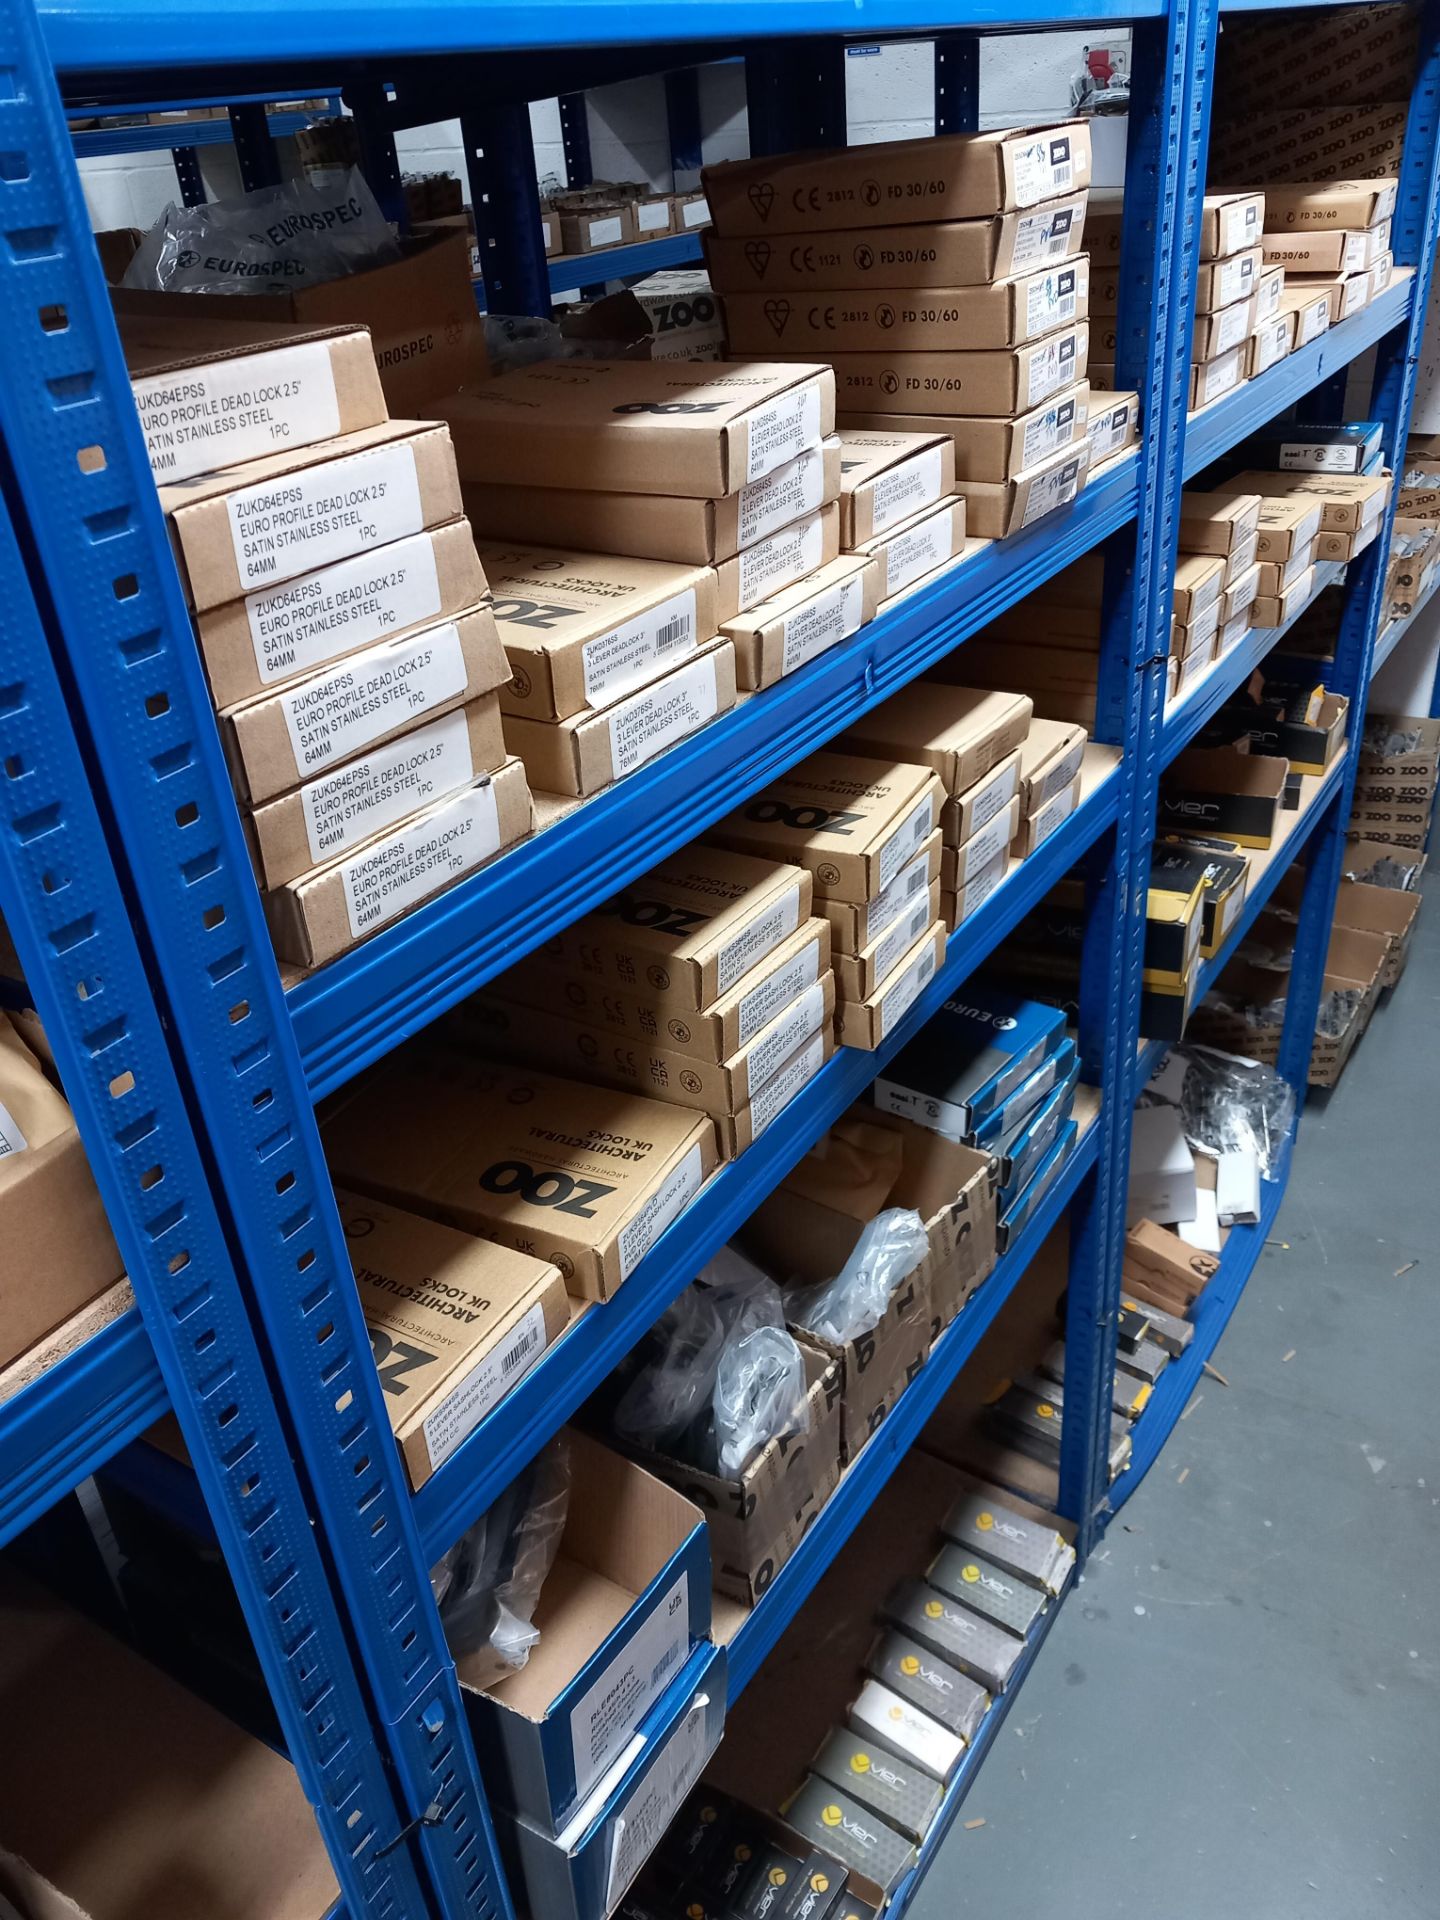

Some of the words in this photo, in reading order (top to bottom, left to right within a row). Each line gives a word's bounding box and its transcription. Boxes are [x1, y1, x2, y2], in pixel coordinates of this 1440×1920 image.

[1366, 31, 1393, 50] ZOO
[1335, 49, 1361, 70] ZOO
[1356, 63, 1383, 83] ZOO
[1328, 112, 1353, 131] ZOO
[1378, 112, 1404, 130] ZOO
[1350, 127, 1374, 144] ZOO
[1370, 140, 1394, 157] ZOO
[1340, 153, 1365, 170] ZOO
[1361, 166, 1386, 179] ZOO
[887, 185, 903, 198] FD
[908, 180, 945, 196] 30/60
[268, 197, 363, 246] EUROSPEC
[1312, 210, 1337, 219] 30/60
[204, 257, 305, 276] EUROSPEC
[818, 254, 841, 266] 1121
[881, 251, 895, 264] FD
[898, 248, 937, 263] 30/60
[1269, 251, 1281, 260] FD
[1282, 251, 1310, 260] 30/60
[653, 296, 715, 332] ZOO
[841, 310, 869, 322] 2812
[902, 310, 917, 322] FD
[921, 308, 959, 322] 30/60
[376, 333, 434, 370] UROSPEC
[846, 376, 873, 388] 2812
[905, 379, 921, 390] FD
[924, 377, 961, 392] 30/60
[137, 382, 205, 410] UKD64EPSS
[613, 400, 736, 414] ZOO
[142, 411, 169, 430] URO
[171, 400, 217, 423] PROFILE
[220, 392, 251, 411] DEAD
[253, 385, 281, 403] LOCK
[146, 431, 174, 451] ATIN
[175, 416, 236, 443] STAINLESS
[238, 407, 273, 427] STEEL
[269, 422, 289, 439] 1PC
[150, 452, 176, 471] 4MM
[235, 486, 303, 519] ZUKD64EPSS
[747, 494, 763, 513] LEVER
[765, 486, 778, 503] DEAD
[779, 478, 793, 494] LOCK
[1287, 487, 1358, 497] ZOO
[1416, 494, 1436, 505] ZOO
[240, 516, 270, 538] EURO
[272, 504, 313, 528] PROFILE
[315, 495, 343, 515] DEAD
[343, 487, 370, 507] LOCK
[741, 510, 757, 528] SATIN
[758, 494, 786, 519] STAINLESS
[787, 485, 803, 503] STEEL
[795, 497, 804, 512] 1PC
[243, 536, 274, 558] SATIN
[275, 519, 330, 548] STAINLESS
[331, 509, 362, 530] STEEL
[358, 523, 377, 541] 1PC
[246, 555, 276, 577] 64MM
[498, 575, 627, 598] ARCHITECTURAL
[562, 577, 611, 588] LOCKS
[610, 584, 637, 592] UK
[255, 581, 322, 617] ZUKD64EPSS
[259, 613, 290, 635] EURO
[291, 596, 333, 623] PROFILE
[335, 585, 362, 606] DEAD
[363, 575, 388, 596] LOCK
[262, 631, 294, 654] SATIN
[294, 609, 349, 642] STAINLESS
[350, 596, 381, 620] STEEL
[377, 609, 395, 627] 1PC
[492, 600, 587, 629] ZO
[265, 649, 295, 672] 64MM
[290, 672, 354, 714] ZUKD64EPSS
[295, 706, 325, 731] EURO
[325, 685, 366, 716] PROFILE
[366, 671, 392, 694] DEAD
[392, 658, 416, 681] LOCK
[407, 689, 425, 709] 1PC
[299, 722, 330, 748] SATIN
[329, 696, 381, 732] STAINLESS
[381, 679, 411, 705] STEEL
[617, 732, 621, 744] 3
[623, 718, 643, 740] LEVER
[645, 706, 662, 725] DEAD
[663, 694, 680, 713] LOCK
[688, 709, 699, 725] 1PC
[618, 736, 637, 758] SATIN
[638, 713, 672, 744] STAINLESS
[673, 699, 693, 721] STEEL
[304, 740, 332, 764] 64MM
[619, 749, 638, 771] 76MM
[1369, 766, 1395, 775] ZOO
[1401, 766, 1428, 775] ZOO
[1401, 786, 1427, 795] ZOO
[745, 801, 867, 836] ZOO
[1366, 812, 1391, 821] ZOO
[1396, 813, 1423, 823] ZOO
[1395, 833, 1421, 843] ZOO
[349, 842, 404, 882] ZUKD64EPSS
[352, 873, 378, 897] EURO
[379, 852, 413, 881] PROFILE
[415, 839, 437, 860] DEAD
[438, 826, 458, 847] LOCK
[447, 853, 463, 872] 1PC
[354, 888, 380, 913] SATIN
[381, 861, 426, 896] STAINLESS
[426, 845, 451, 869] STEEL
[356, 903, 381, 927] 64MM
[527, 1126, 647, 1162] ARCHITECTURAL
[587, 1129, 632, 1145] LOCKS
[633, 1140, 654, 1152] UK
[479, 1160, 618, 1219] ZOO
[357, 1268, 481, 1324] ARCHITECTURAL
[419, 1277, 468, 1302] LOCKS
[466, 1295, 492, 1311] UK
[919, 1666, 953, 1690] vier
[869, 1763, 907, 1786] vier
[841, 1815, 878, 1844] vier
